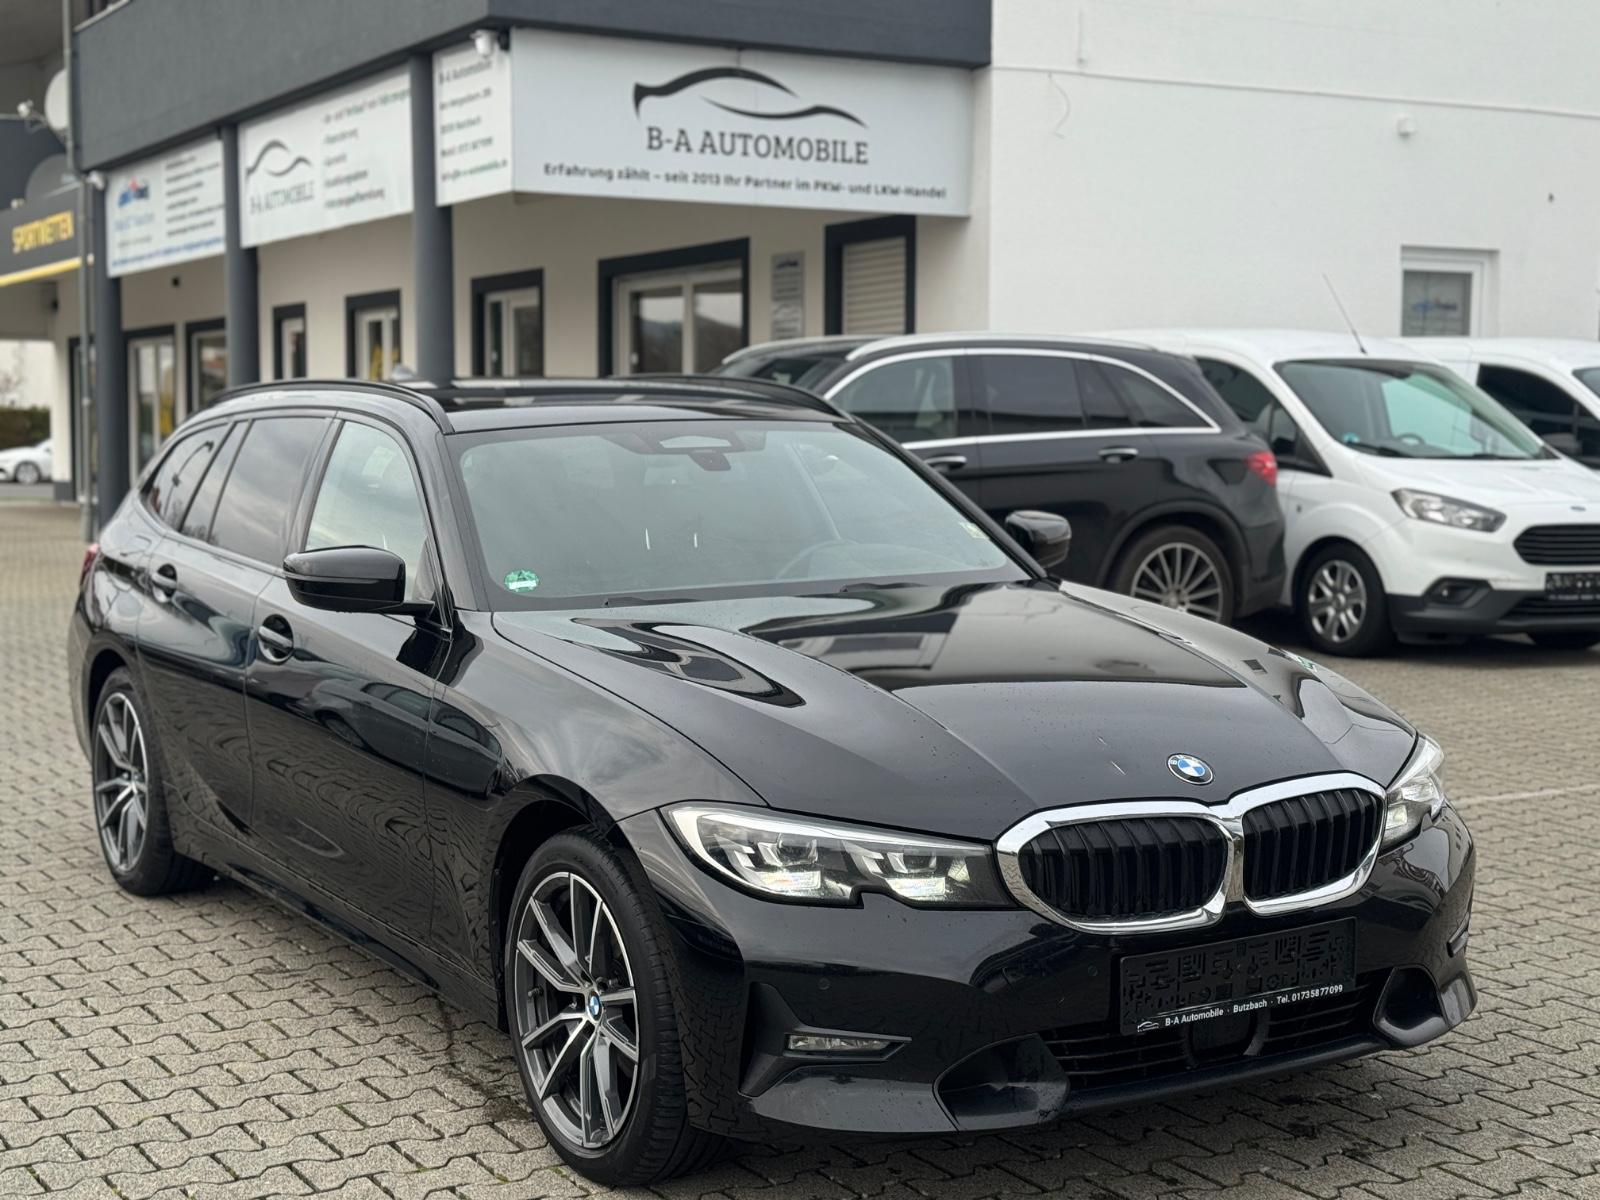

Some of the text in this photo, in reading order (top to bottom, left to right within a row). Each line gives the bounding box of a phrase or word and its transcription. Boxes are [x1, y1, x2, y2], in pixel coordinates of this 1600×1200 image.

[646, 126, 869, 165] B-A AUTOMOBILE
[543, 163, 613, 181] Erfahrung
[617, 166, 650, 181] zählt
[664, 171, 689, 184] seit
[692, 172, 720, 186] 2013
[723, 174, 742, 187] Ihr
[744, 175, 793, 191] Partner
[795, 177, 811, 191] im
[813, 179, 845, 193] PKW-
[849, 181, 871, 195] und
[874, 183, 947, 199] LKW-Handel
[1165, 984, 1343, 1026] B-A Automobile Butzbach Tel. 01735877099
